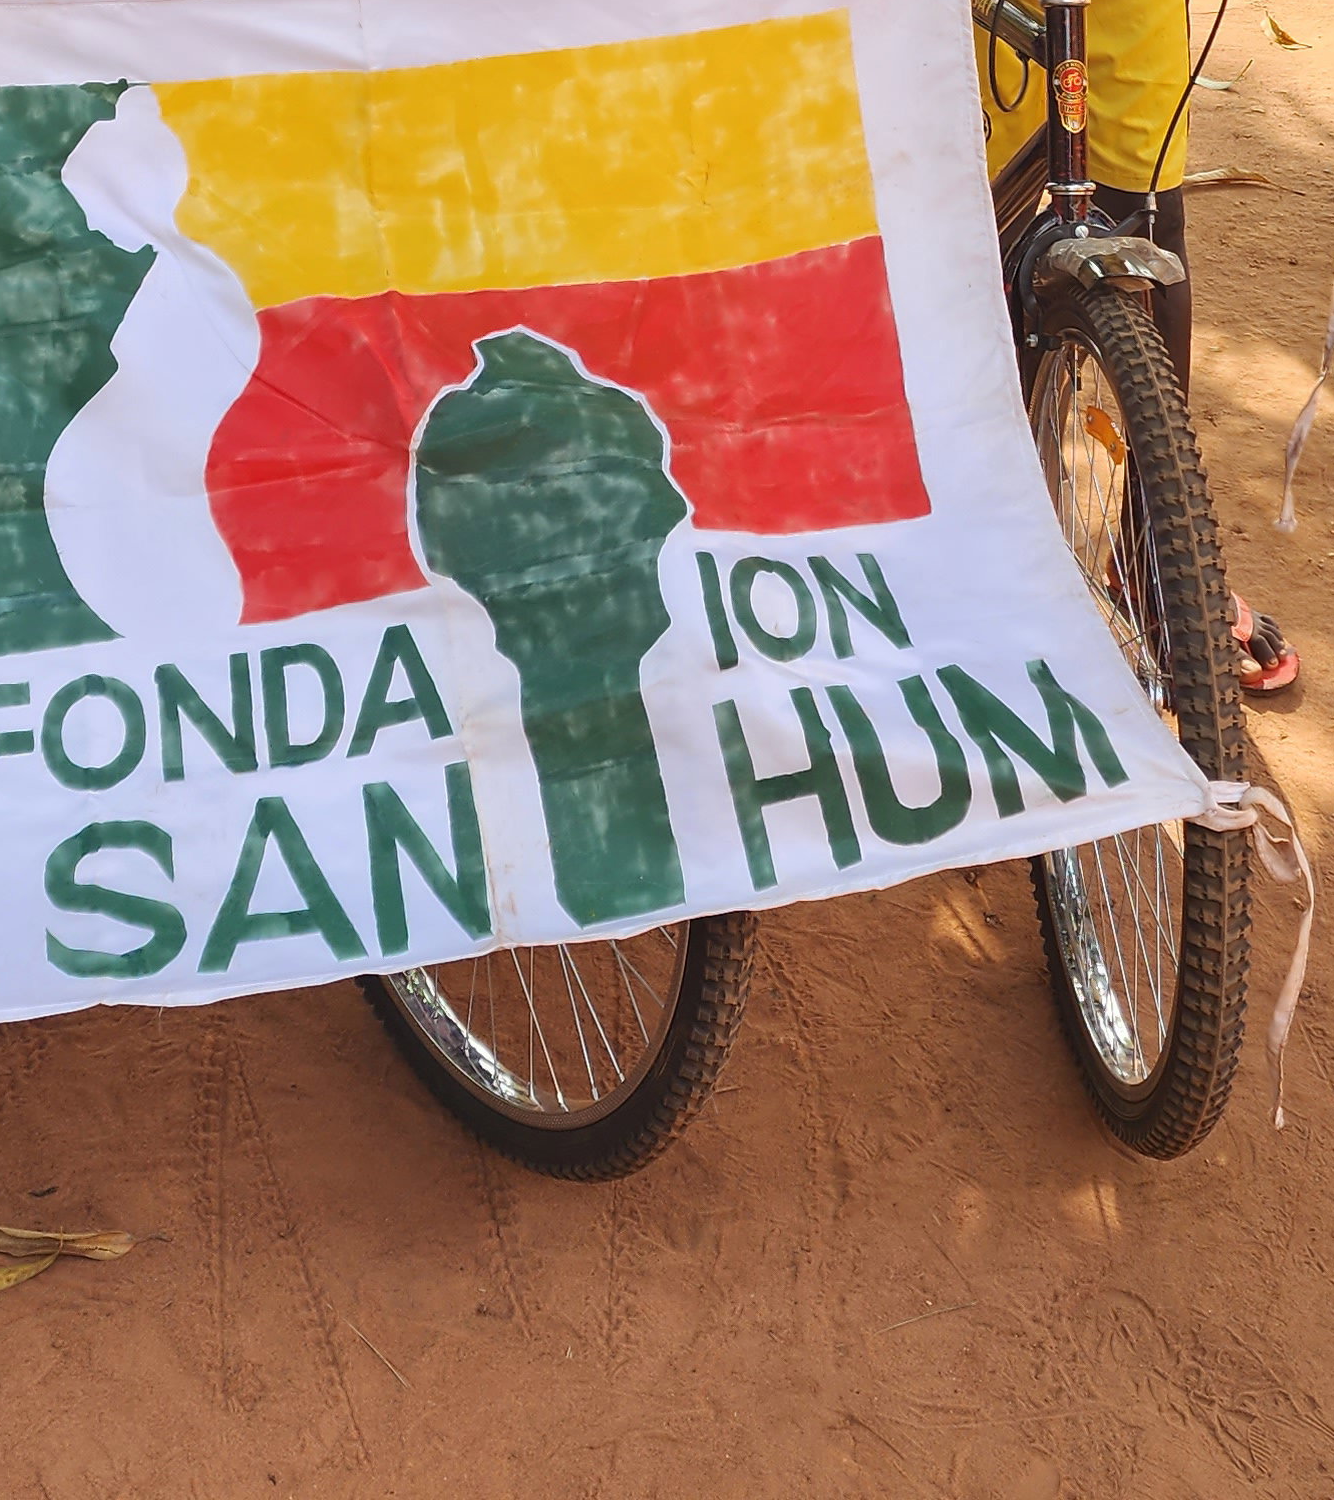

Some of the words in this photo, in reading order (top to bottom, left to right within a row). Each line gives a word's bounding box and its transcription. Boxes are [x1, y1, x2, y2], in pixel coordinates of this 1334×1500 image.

[694, 550, 914, 670] ION
[43, 760, 494, 980] SAN
[713, 658, 1128, 892] HUM
